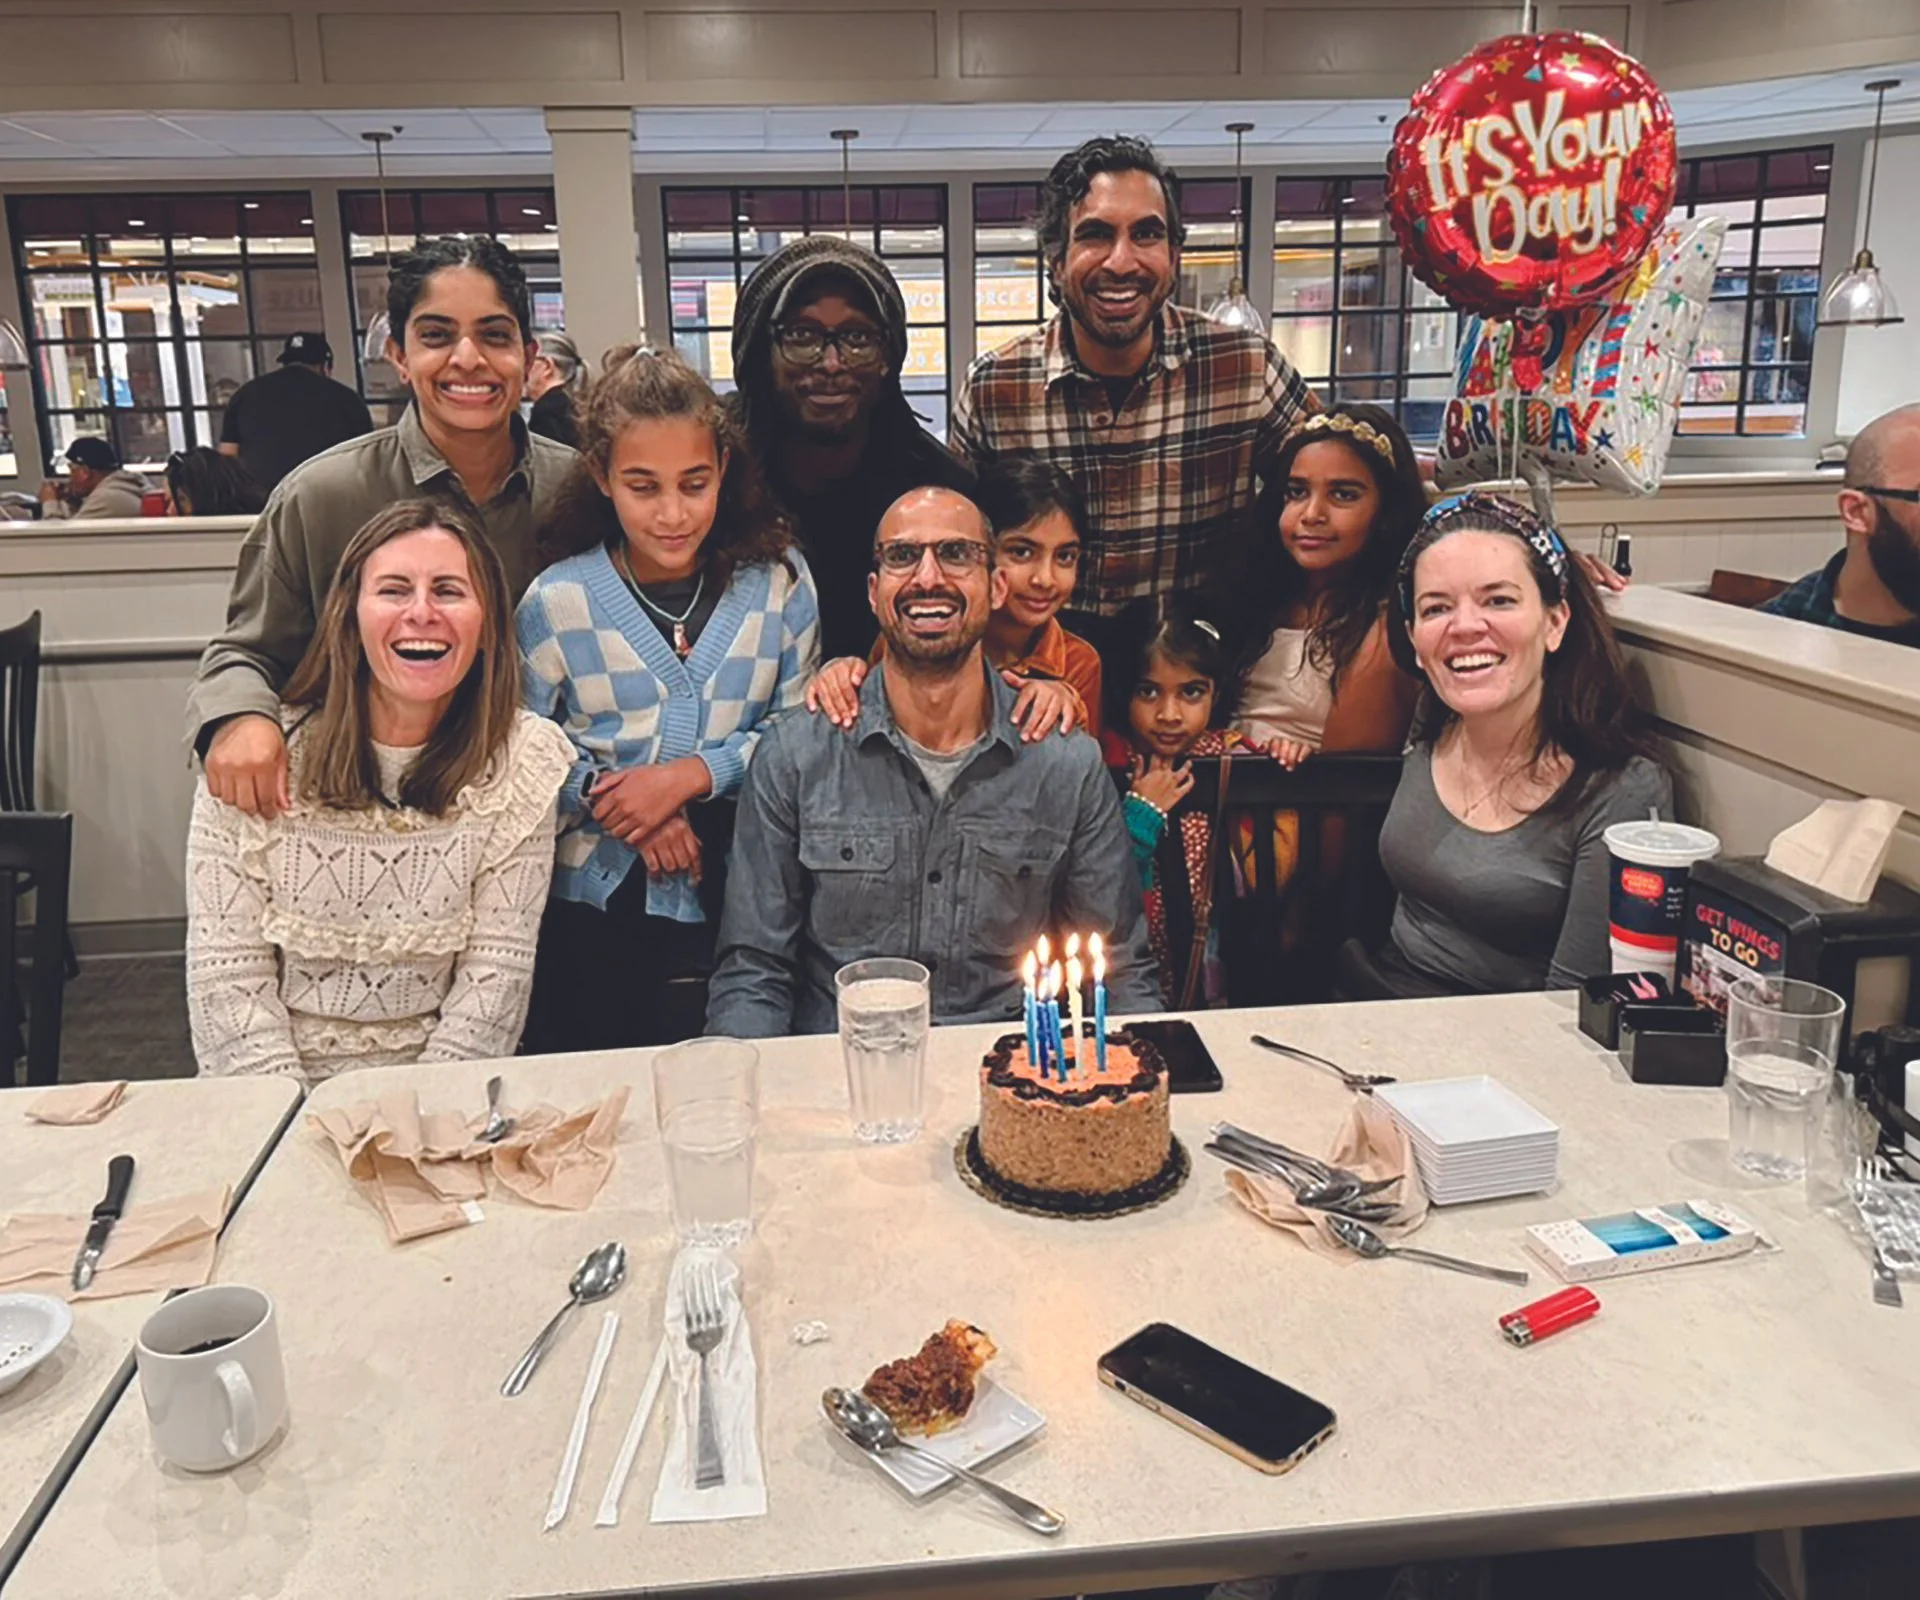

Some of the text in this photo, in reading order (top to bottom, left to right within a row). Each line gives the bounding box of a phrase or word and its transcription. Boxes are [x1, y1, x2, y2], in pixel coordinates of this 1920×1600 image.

[1472, 156, 1623, 266] Day!
[1695, 903, 1782, 961] GET WINGS
[1710, 927, 1759, 967] TO GO
